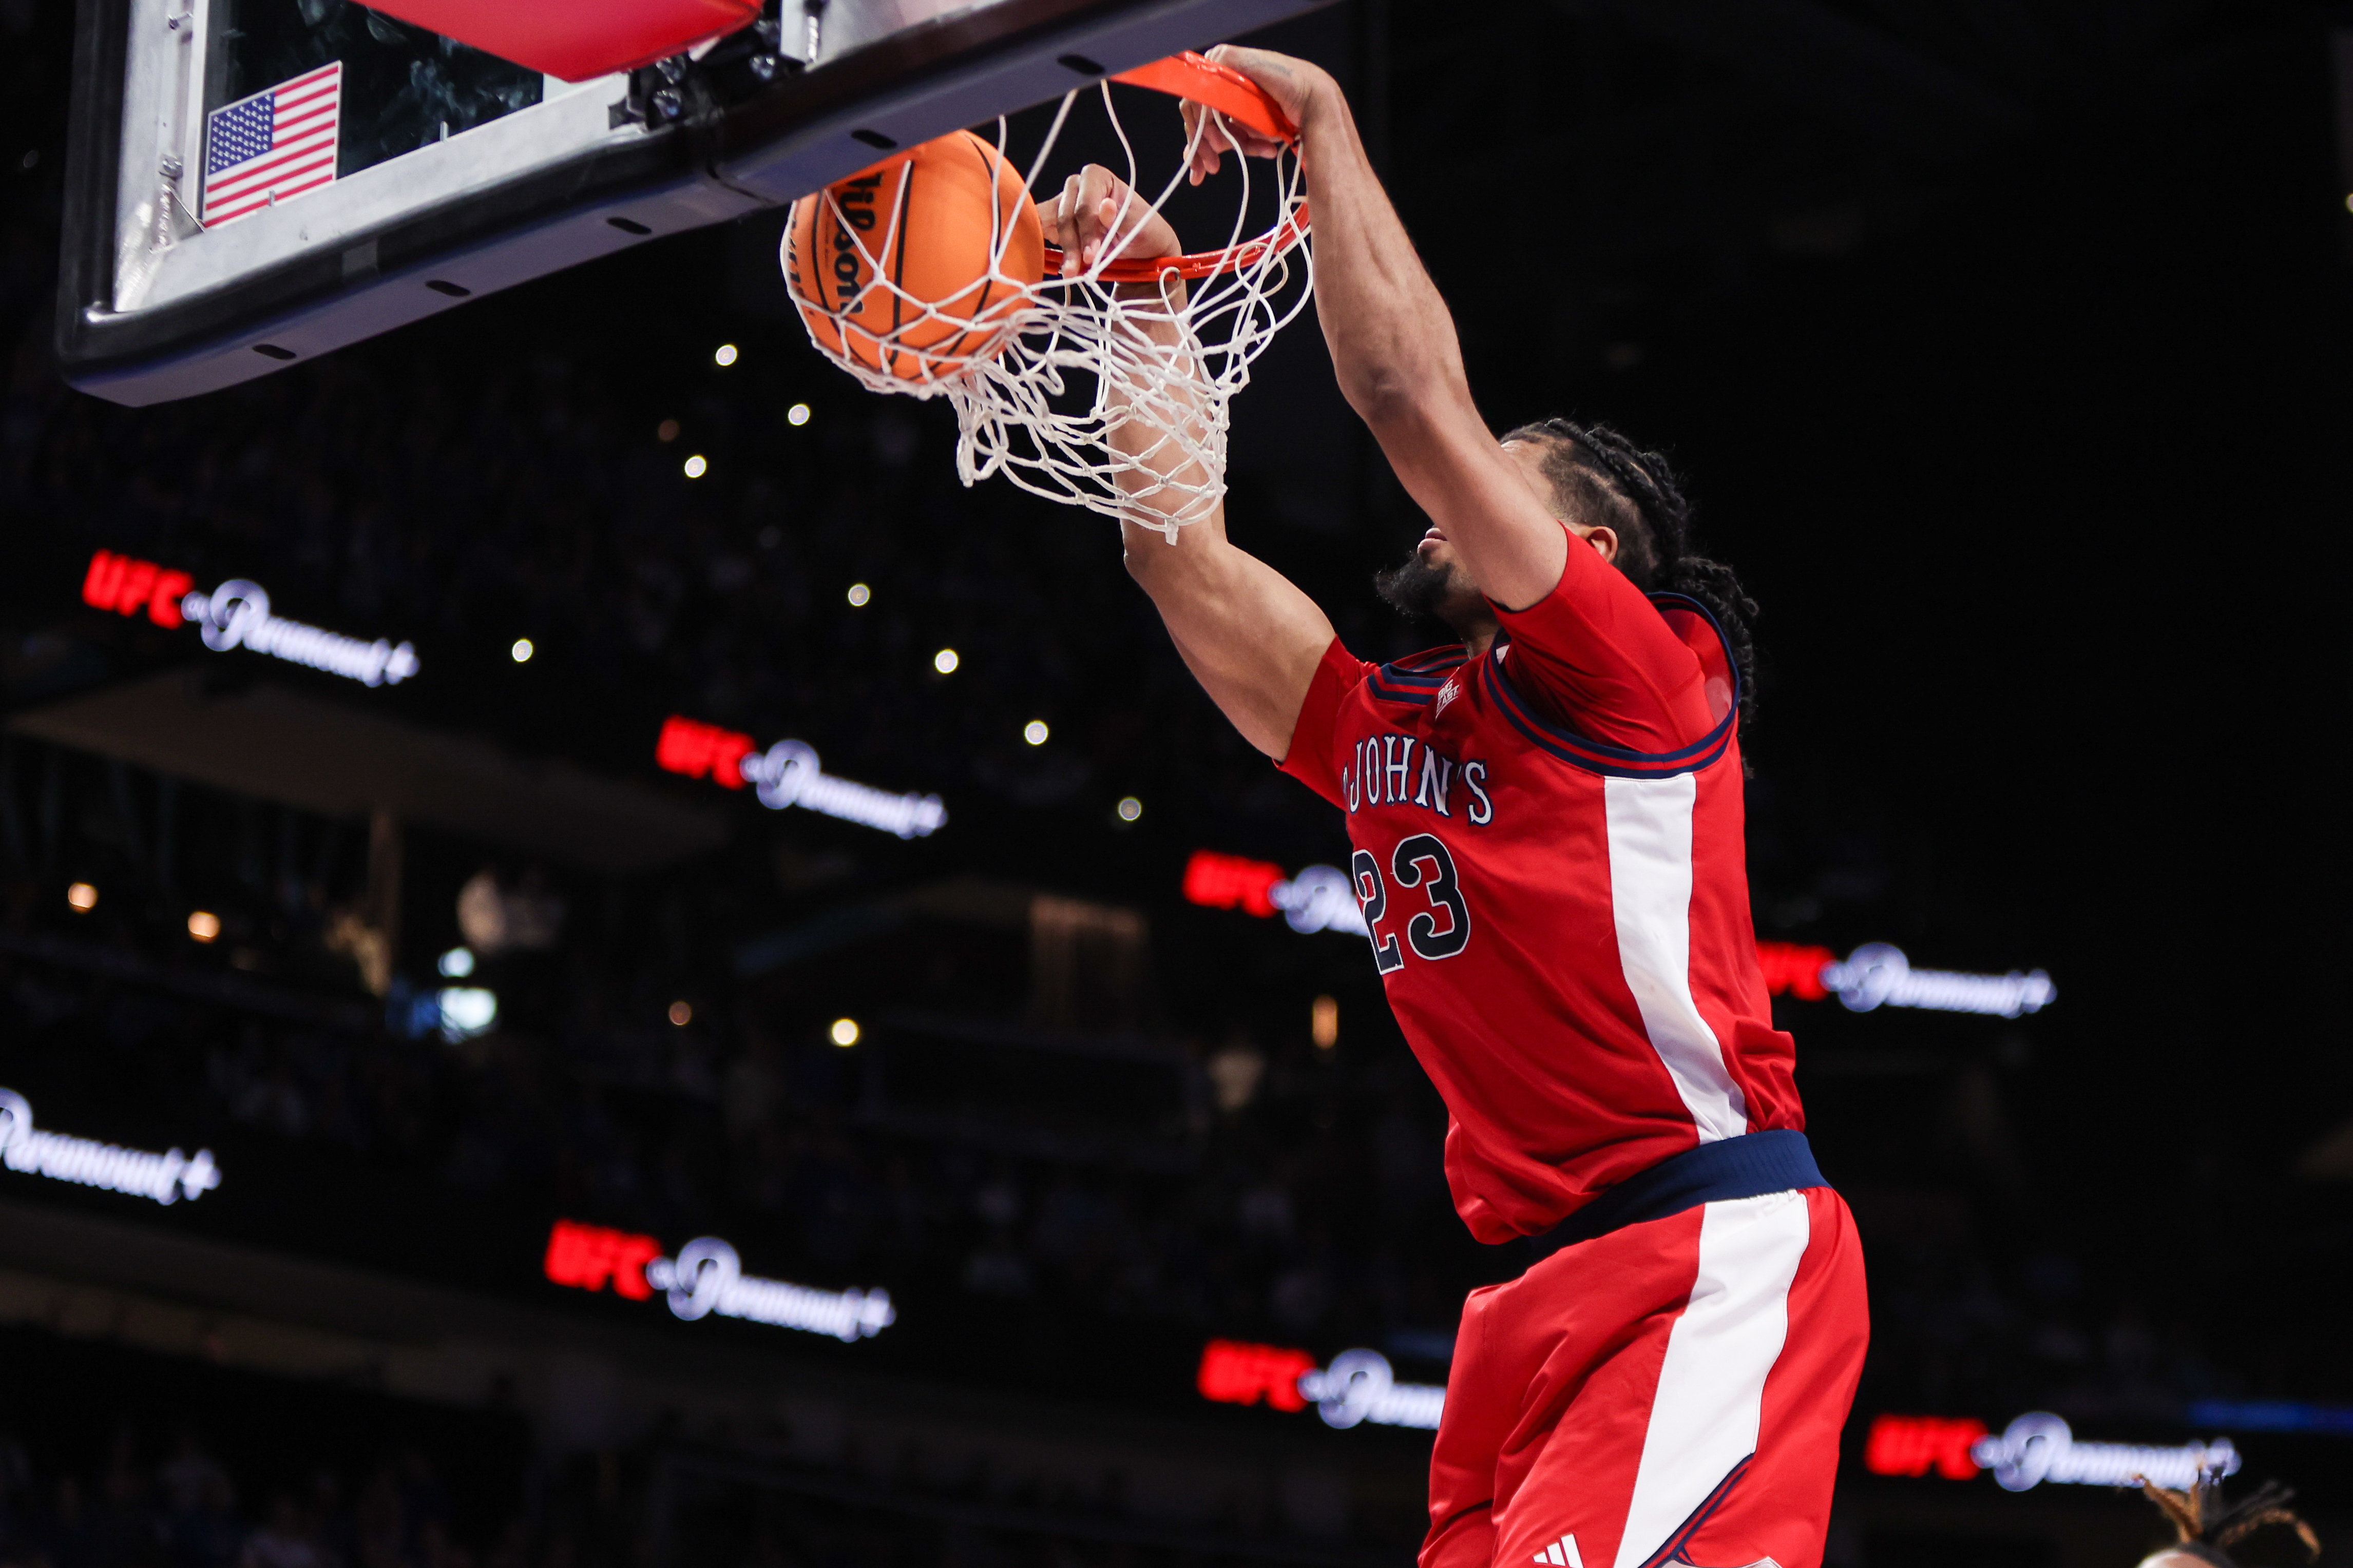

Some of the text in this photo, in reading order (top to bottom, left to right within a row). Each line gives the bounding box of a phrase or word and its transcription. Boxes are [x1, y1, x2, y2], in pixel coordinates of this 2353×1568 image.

[82, 549, 194, 629] UFC
[1437, 684, 1460, 713] EAST
[1438, 679, 1453, 702] BIG
[1352, 833, 1471, 975] 23
